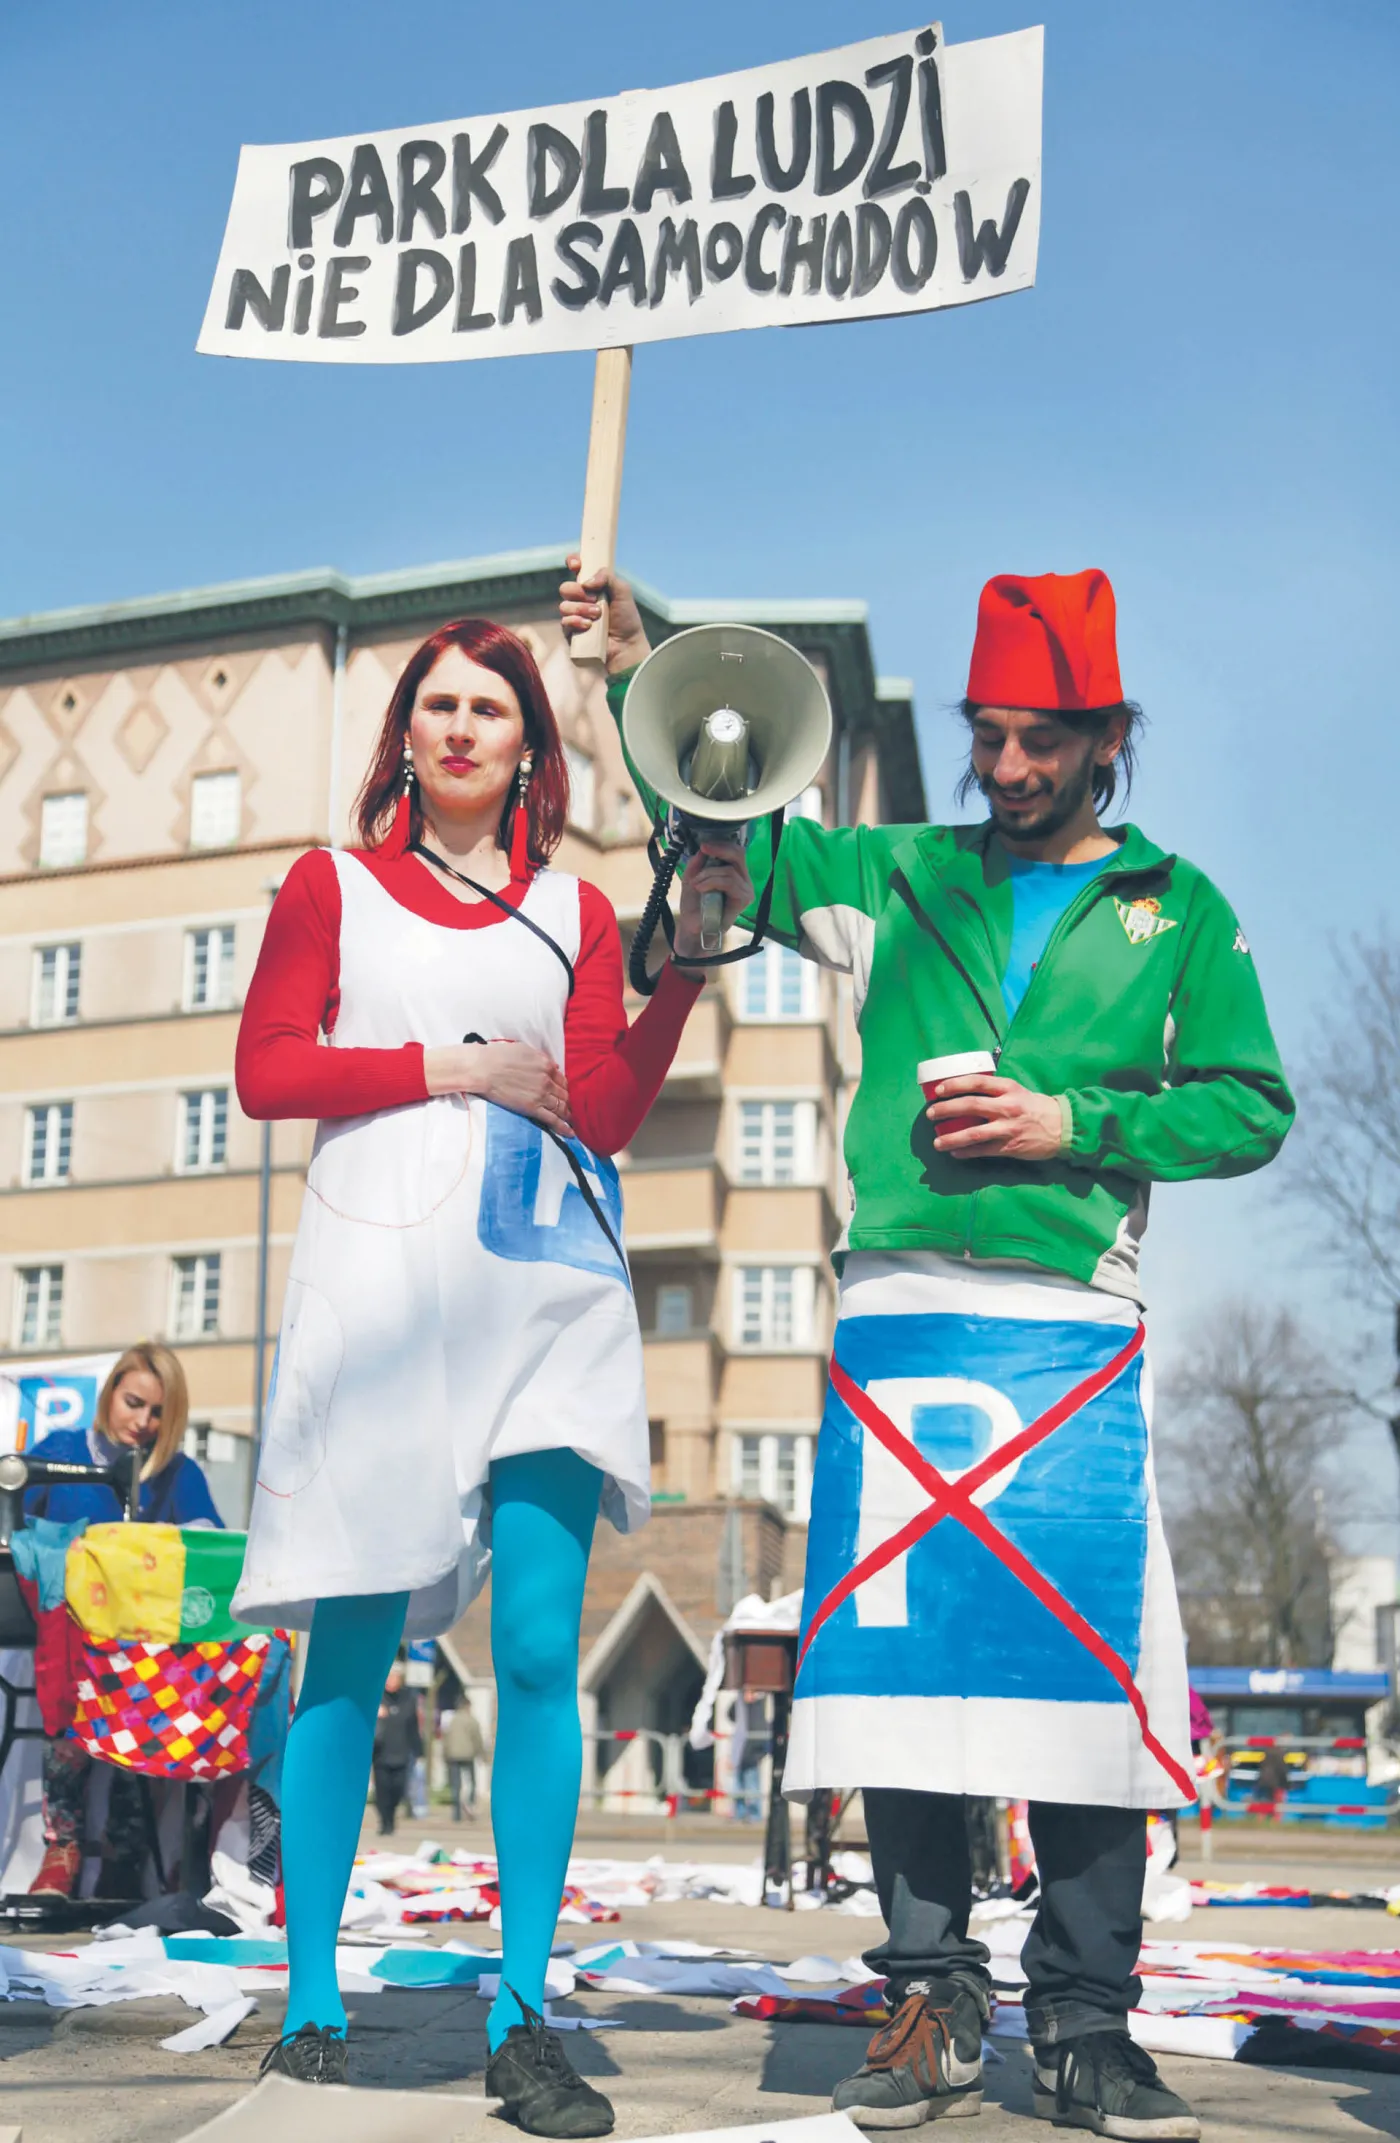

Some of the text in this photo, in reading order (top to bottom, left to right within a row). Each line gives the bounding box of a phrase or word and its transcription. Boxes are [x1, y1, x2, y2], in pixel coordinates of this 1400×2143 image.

[288, 123, 511, 250] PARK
[526, 109, 693, 219] DLA
[392, 233, 543, 336] DLA
[855, 1377, 1023, 1628] P
